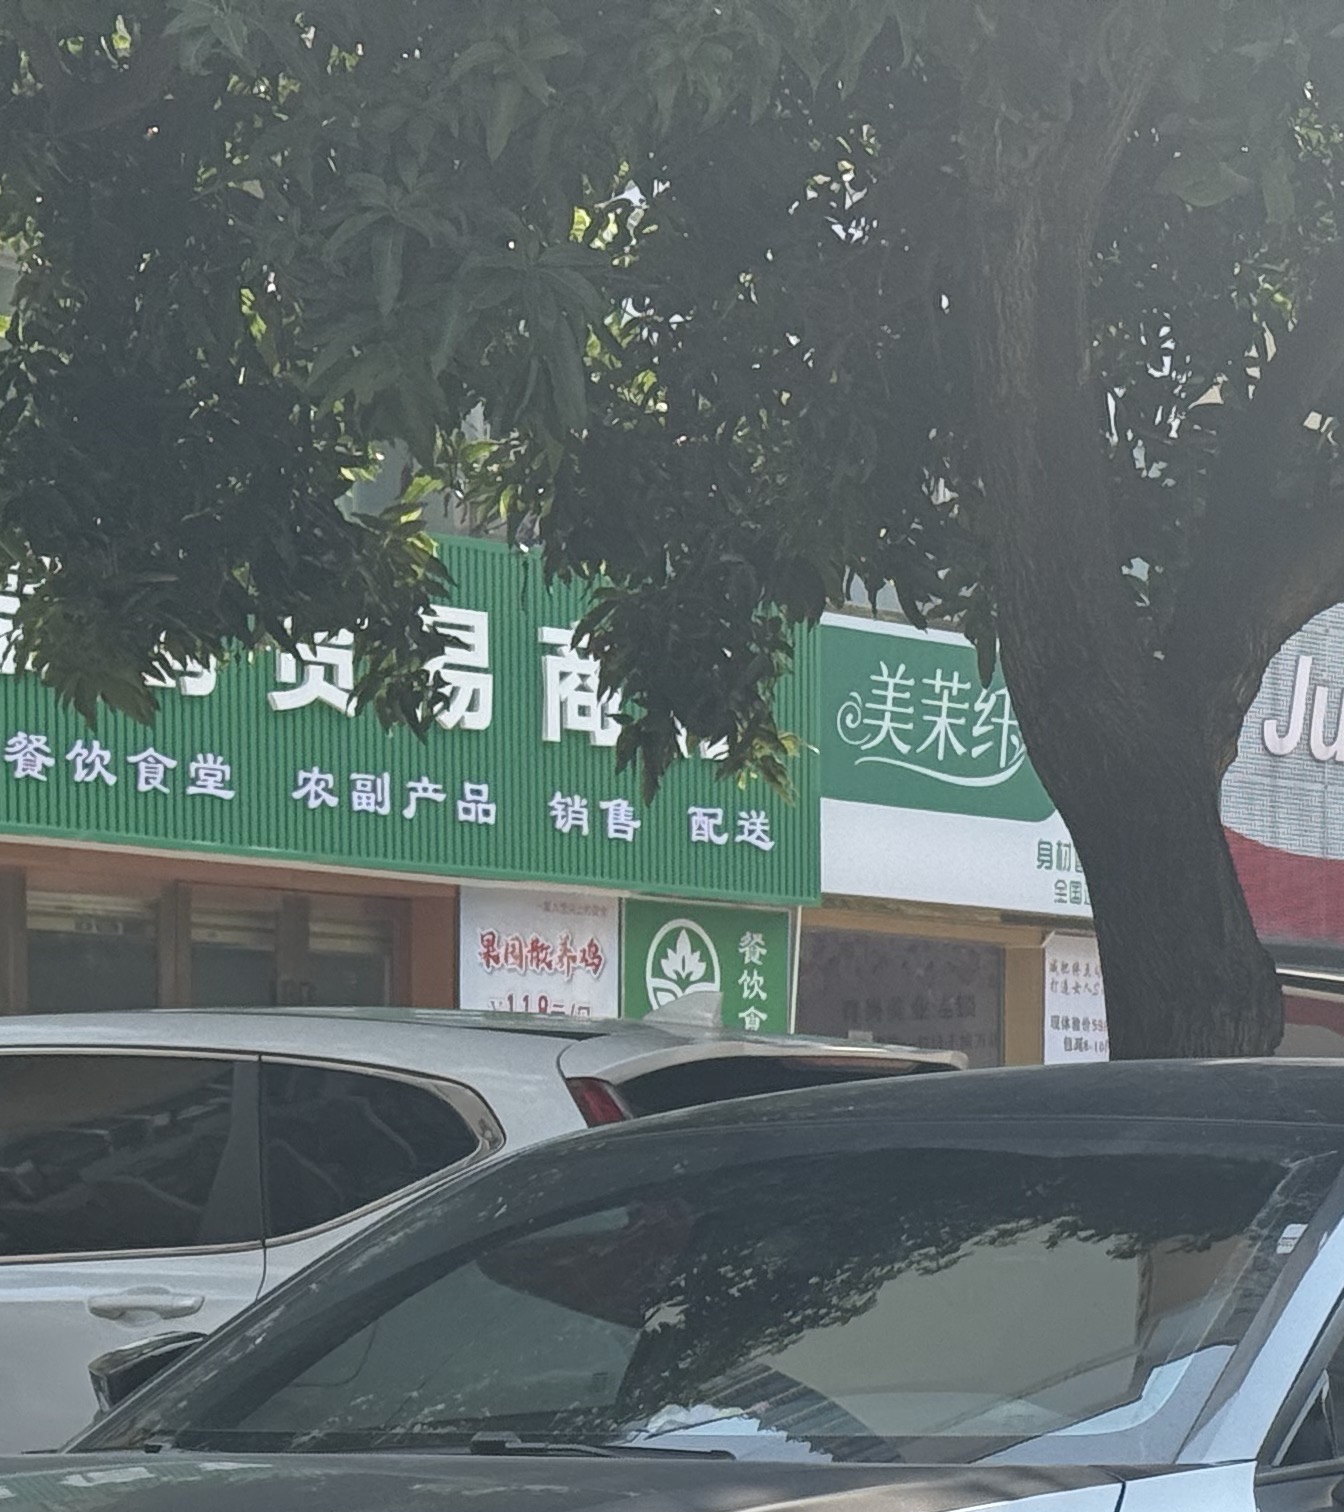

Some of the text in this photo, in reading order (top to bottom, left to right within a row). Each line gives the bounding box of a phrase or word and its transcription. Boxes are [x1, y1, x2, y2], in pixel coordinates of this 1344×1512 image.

[4, 729, 776, 852] 餐饮食堂 农副产品 销售 配送
